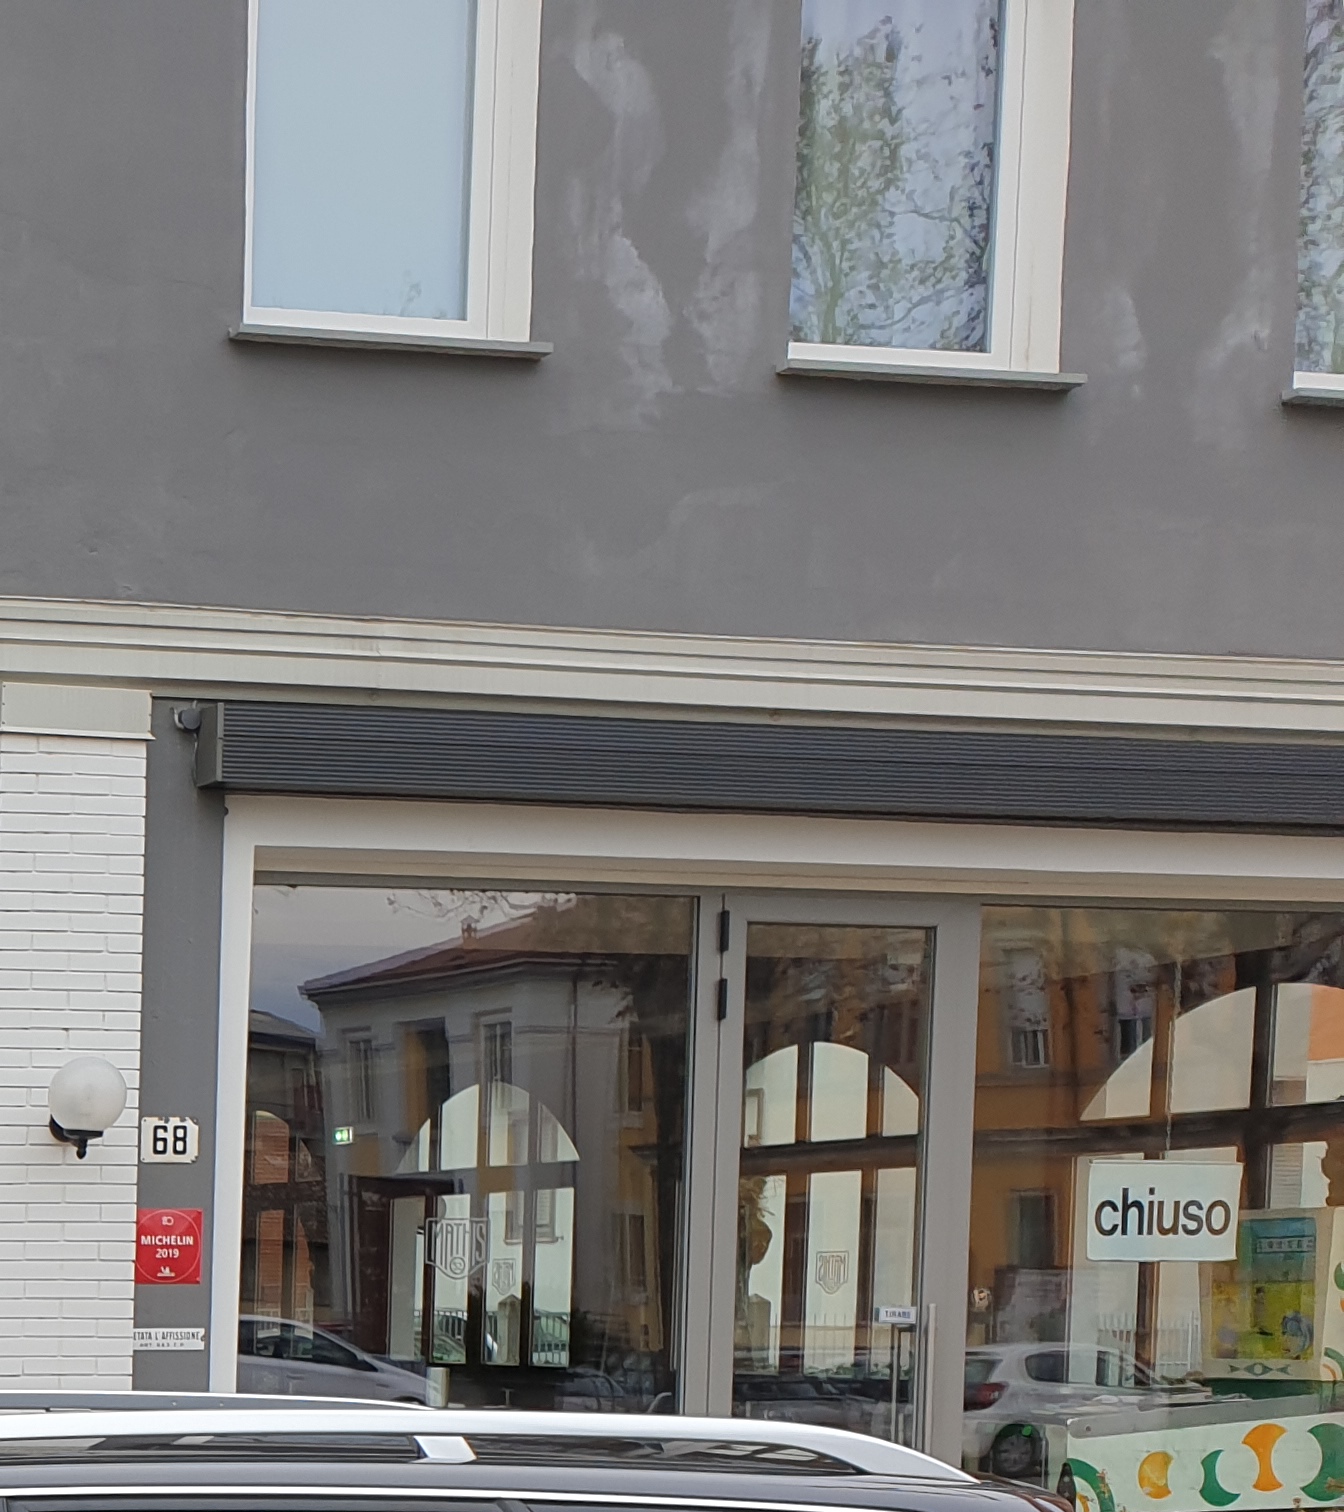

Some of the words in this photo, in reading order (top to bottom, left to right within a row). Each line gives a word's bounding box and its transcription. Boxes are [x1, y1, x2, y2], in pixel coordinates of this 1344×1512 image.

[152, 1124, 188, 1156] 68
[1094, 1186, 1232, 1237] chiuso
[140, 1234, 194, 1247] MICHELIN
[155, 1247, 180, 1259] 2019
[133, 1331, 152, 1341] ETATA
